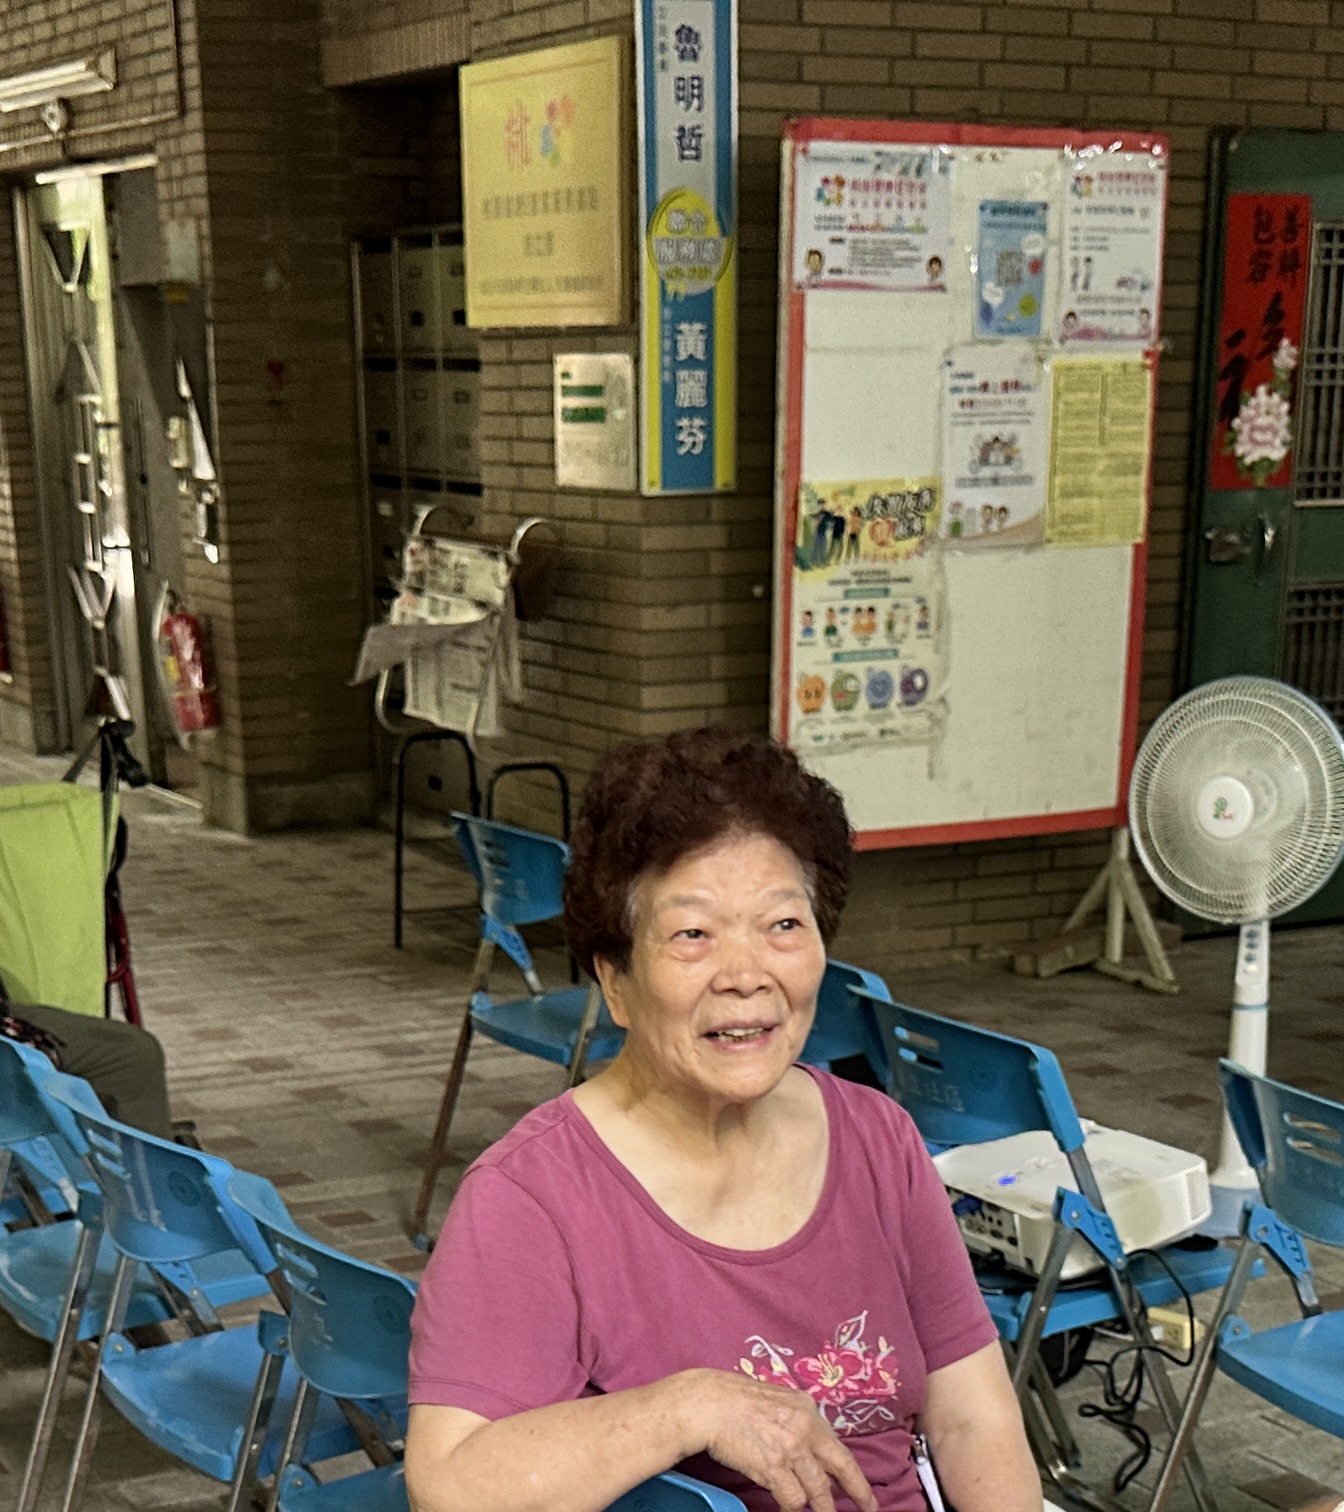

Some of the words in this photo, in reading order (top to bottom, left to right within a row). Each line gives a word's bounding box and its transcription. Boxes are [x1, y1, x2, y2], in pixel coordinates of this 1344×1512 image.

[674, 23, 704, 162] 魯明哲
[675, 322, 708, 456] 黃麗芬
